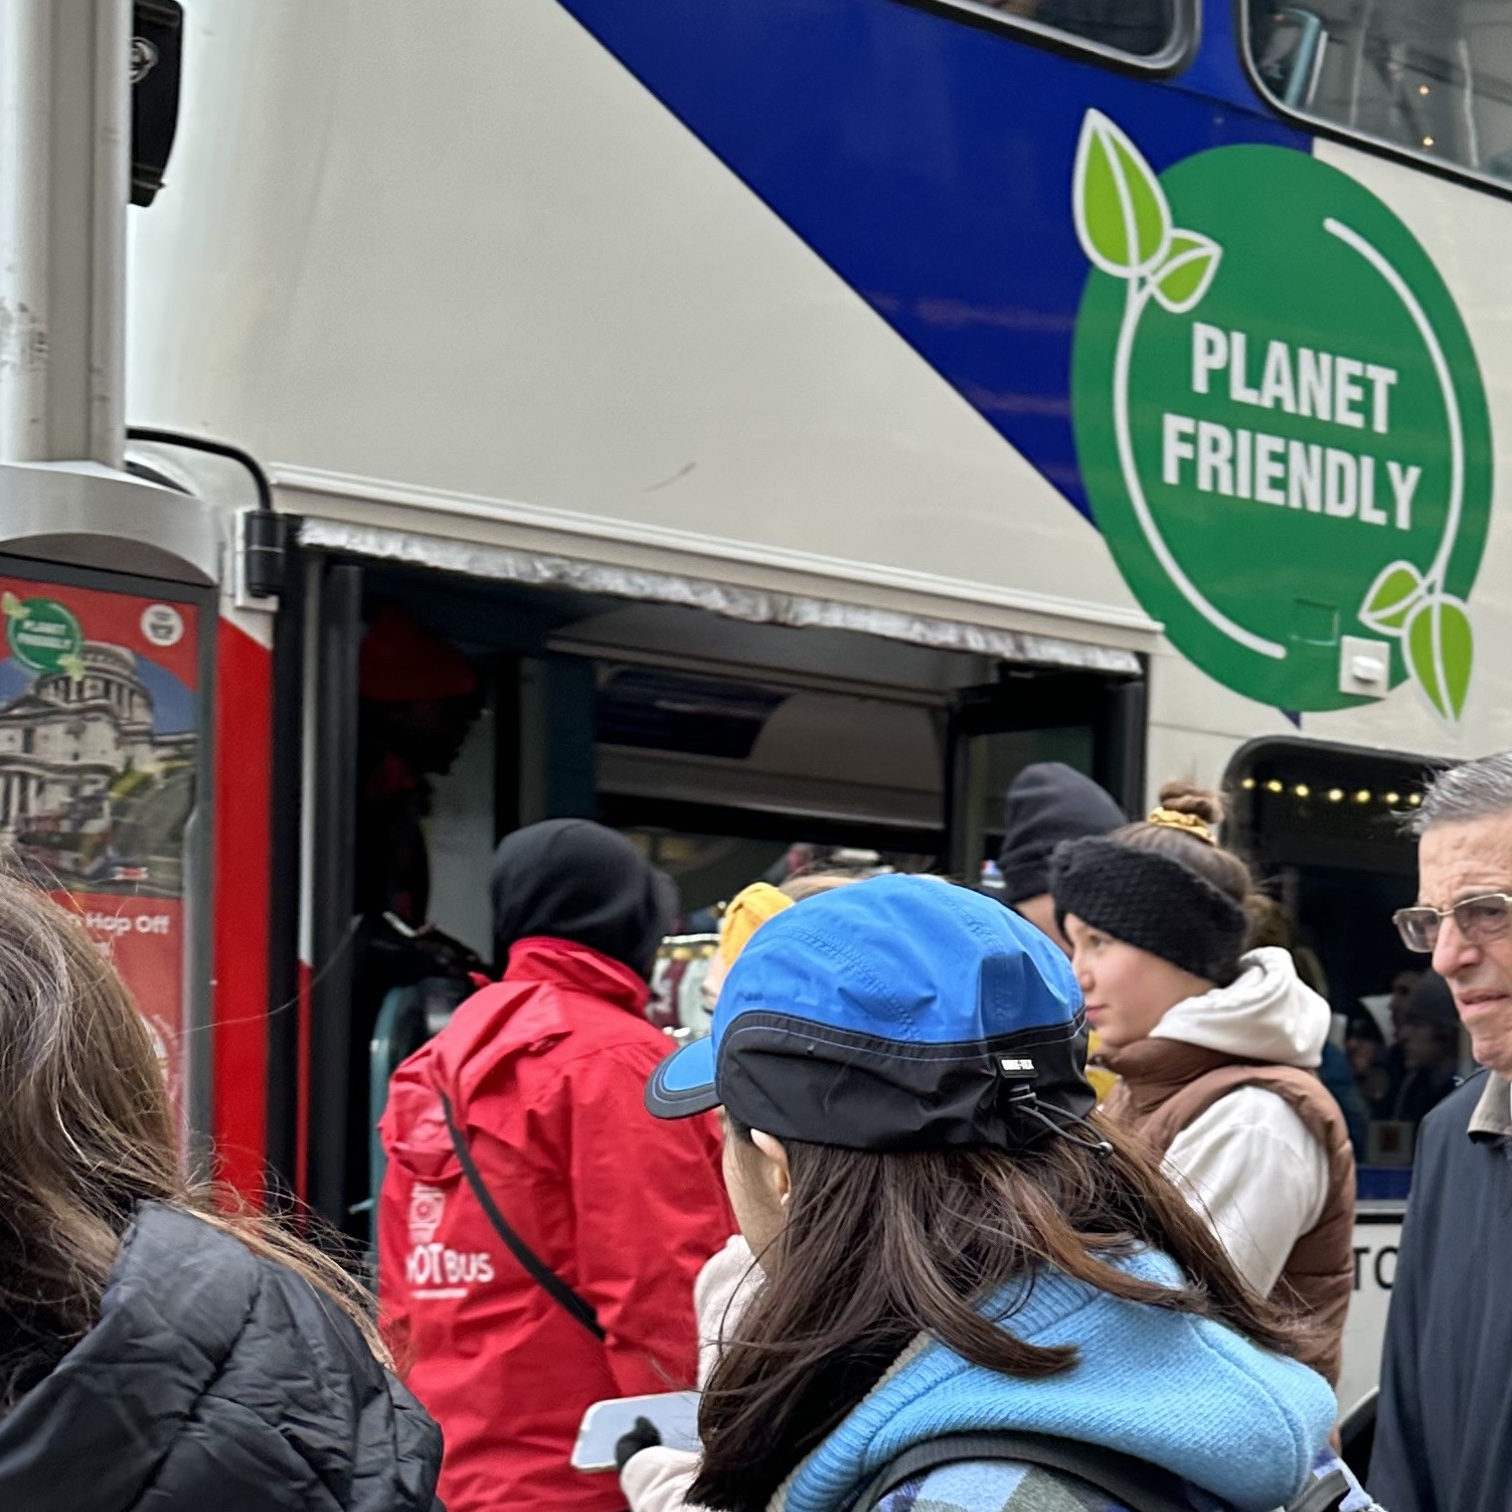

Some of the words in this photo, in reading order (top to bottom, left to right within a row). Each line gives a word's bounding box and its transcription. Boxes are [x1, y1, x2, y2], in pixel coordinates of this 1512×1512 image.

[1190, 322, 1398, 434] PLANET
[1162, 413, 1422, 530] FRIENDLY
[85, 911, 132, 936] Hop
[135, 914, 170, 935] Off
